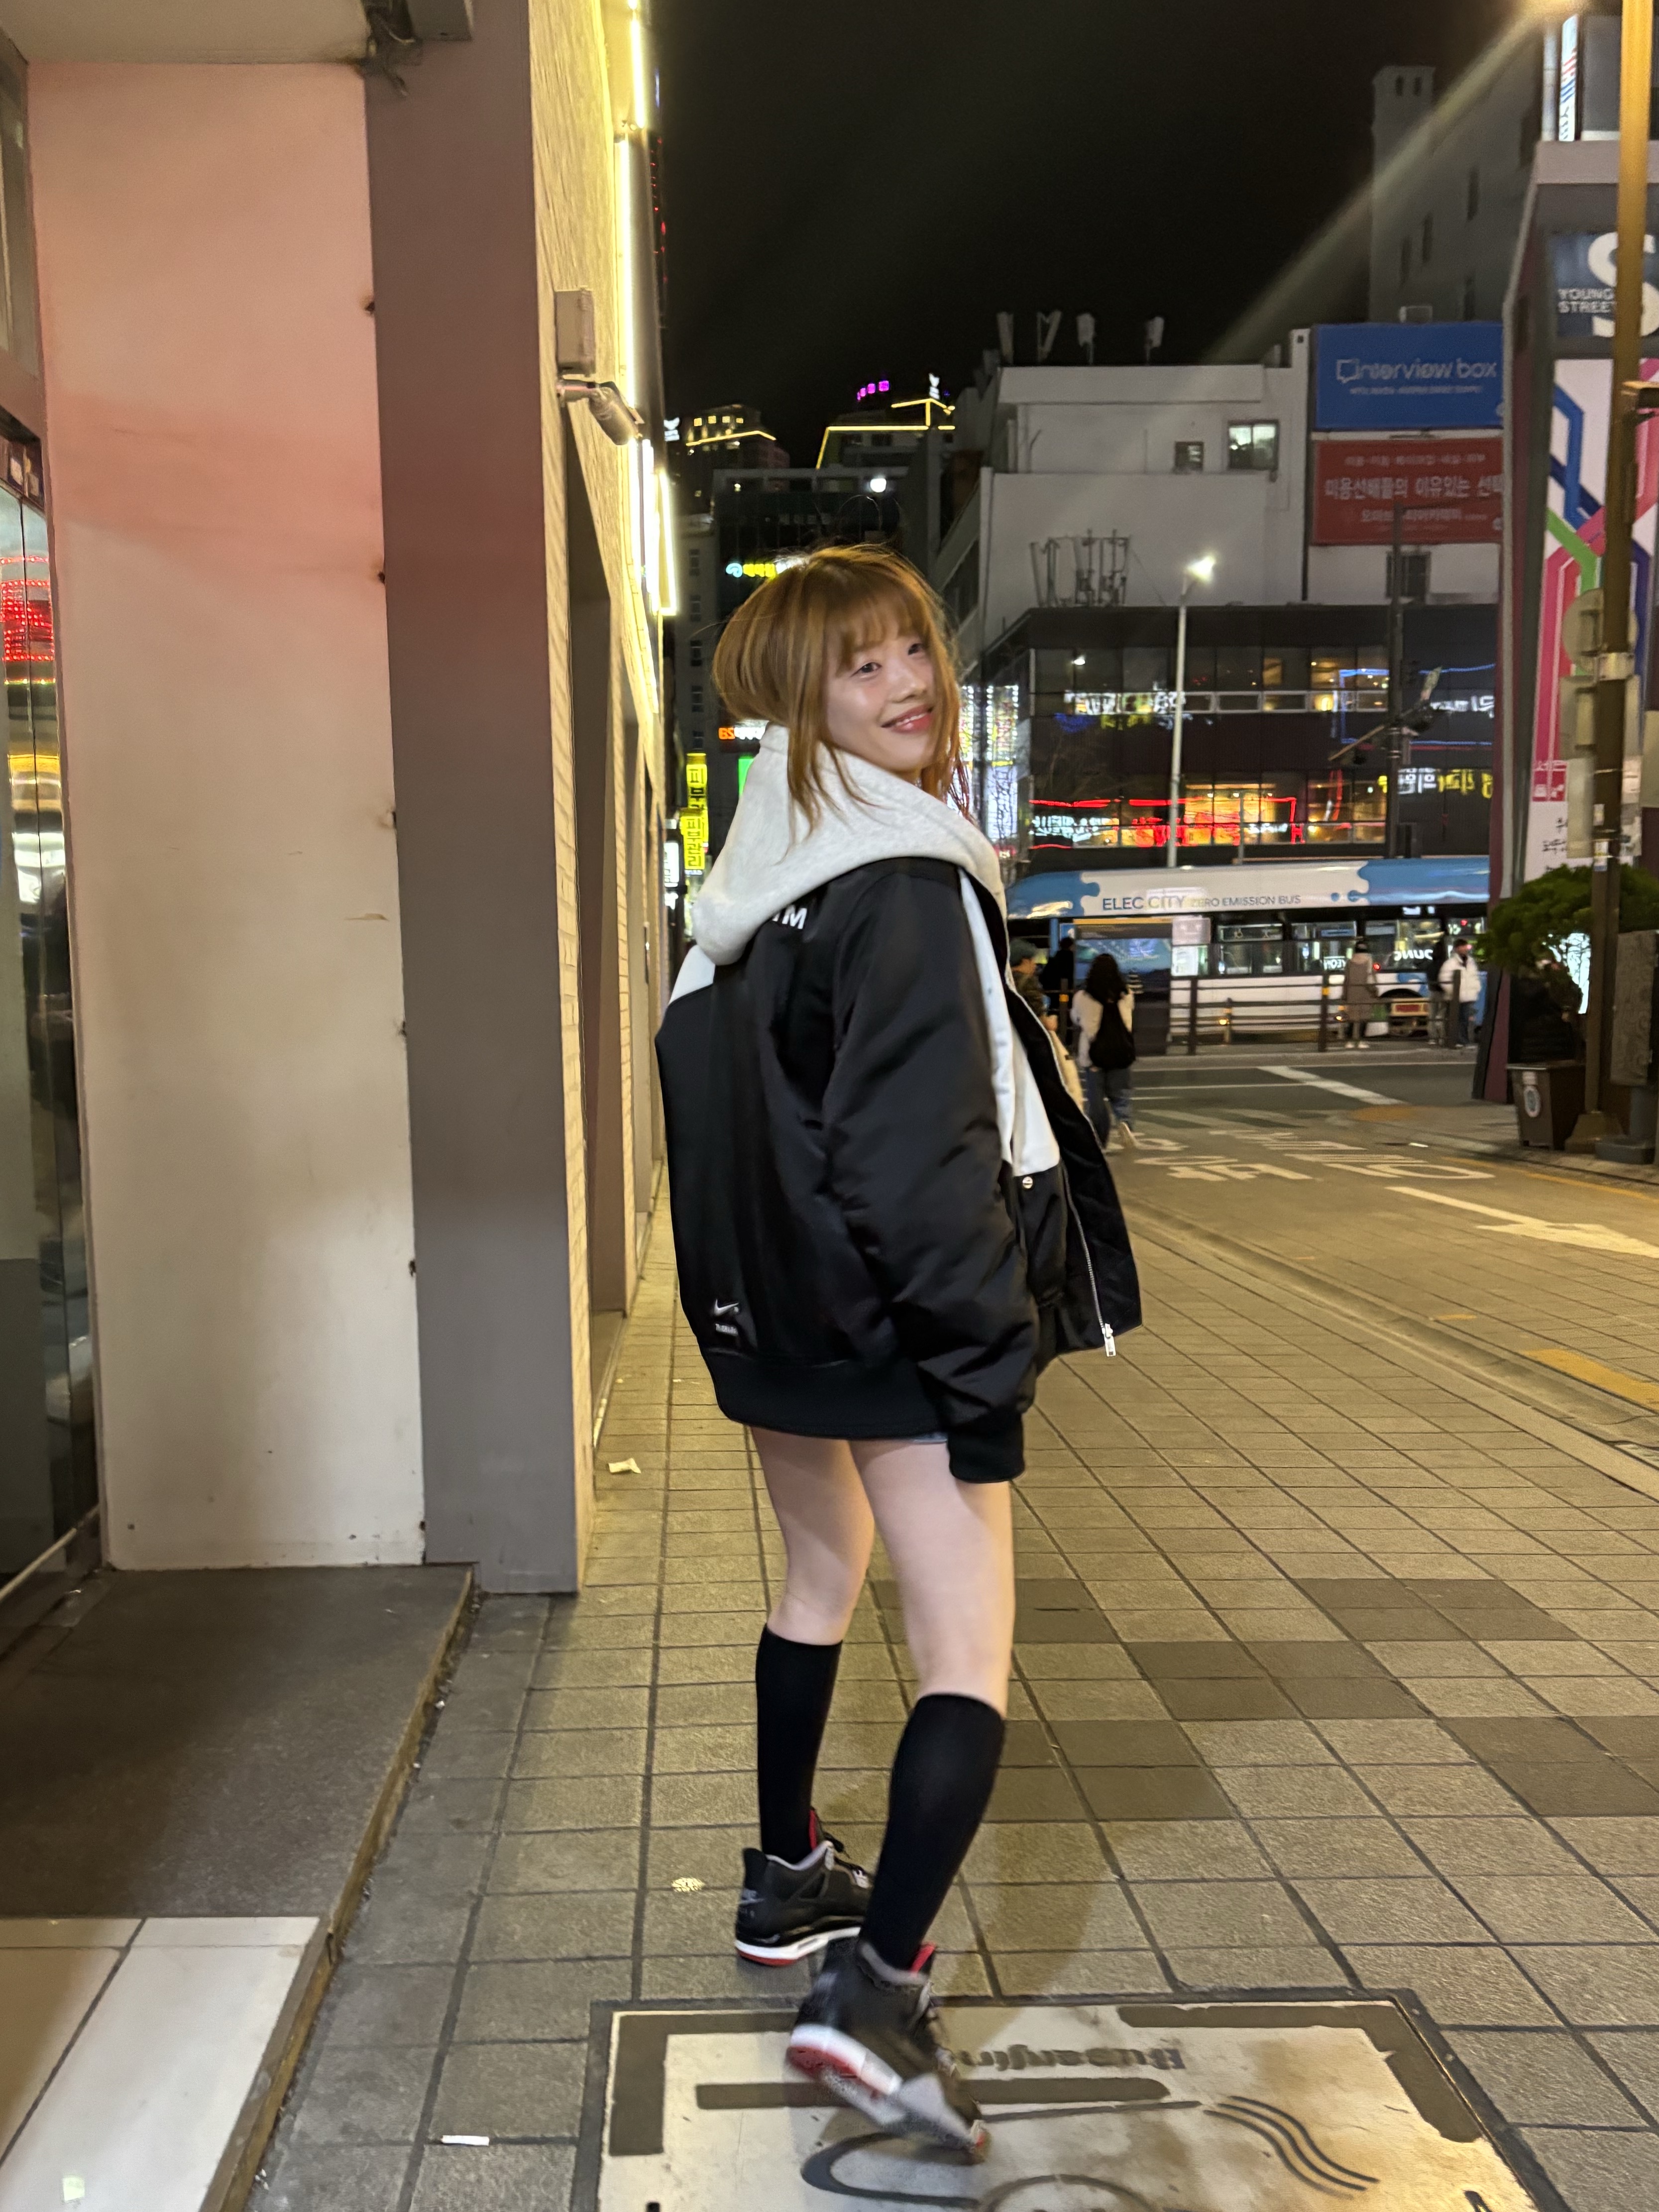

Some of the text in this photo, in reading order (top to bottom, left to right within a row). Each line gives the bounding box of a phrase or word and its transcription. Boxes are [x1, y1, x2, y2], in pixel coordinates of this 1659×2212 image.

[1558, 288, 1614, 300] YOUNG
[1456, 357, 1497, 379] box
[1103, 896, 1144, 911] ELEC
[1148, 895, 1185, 909] CITY
[1221, 895, 1275, 906] EMISSION
[1280, 894, 1302, 905] BUS
[772, 904, 807, 929] M
